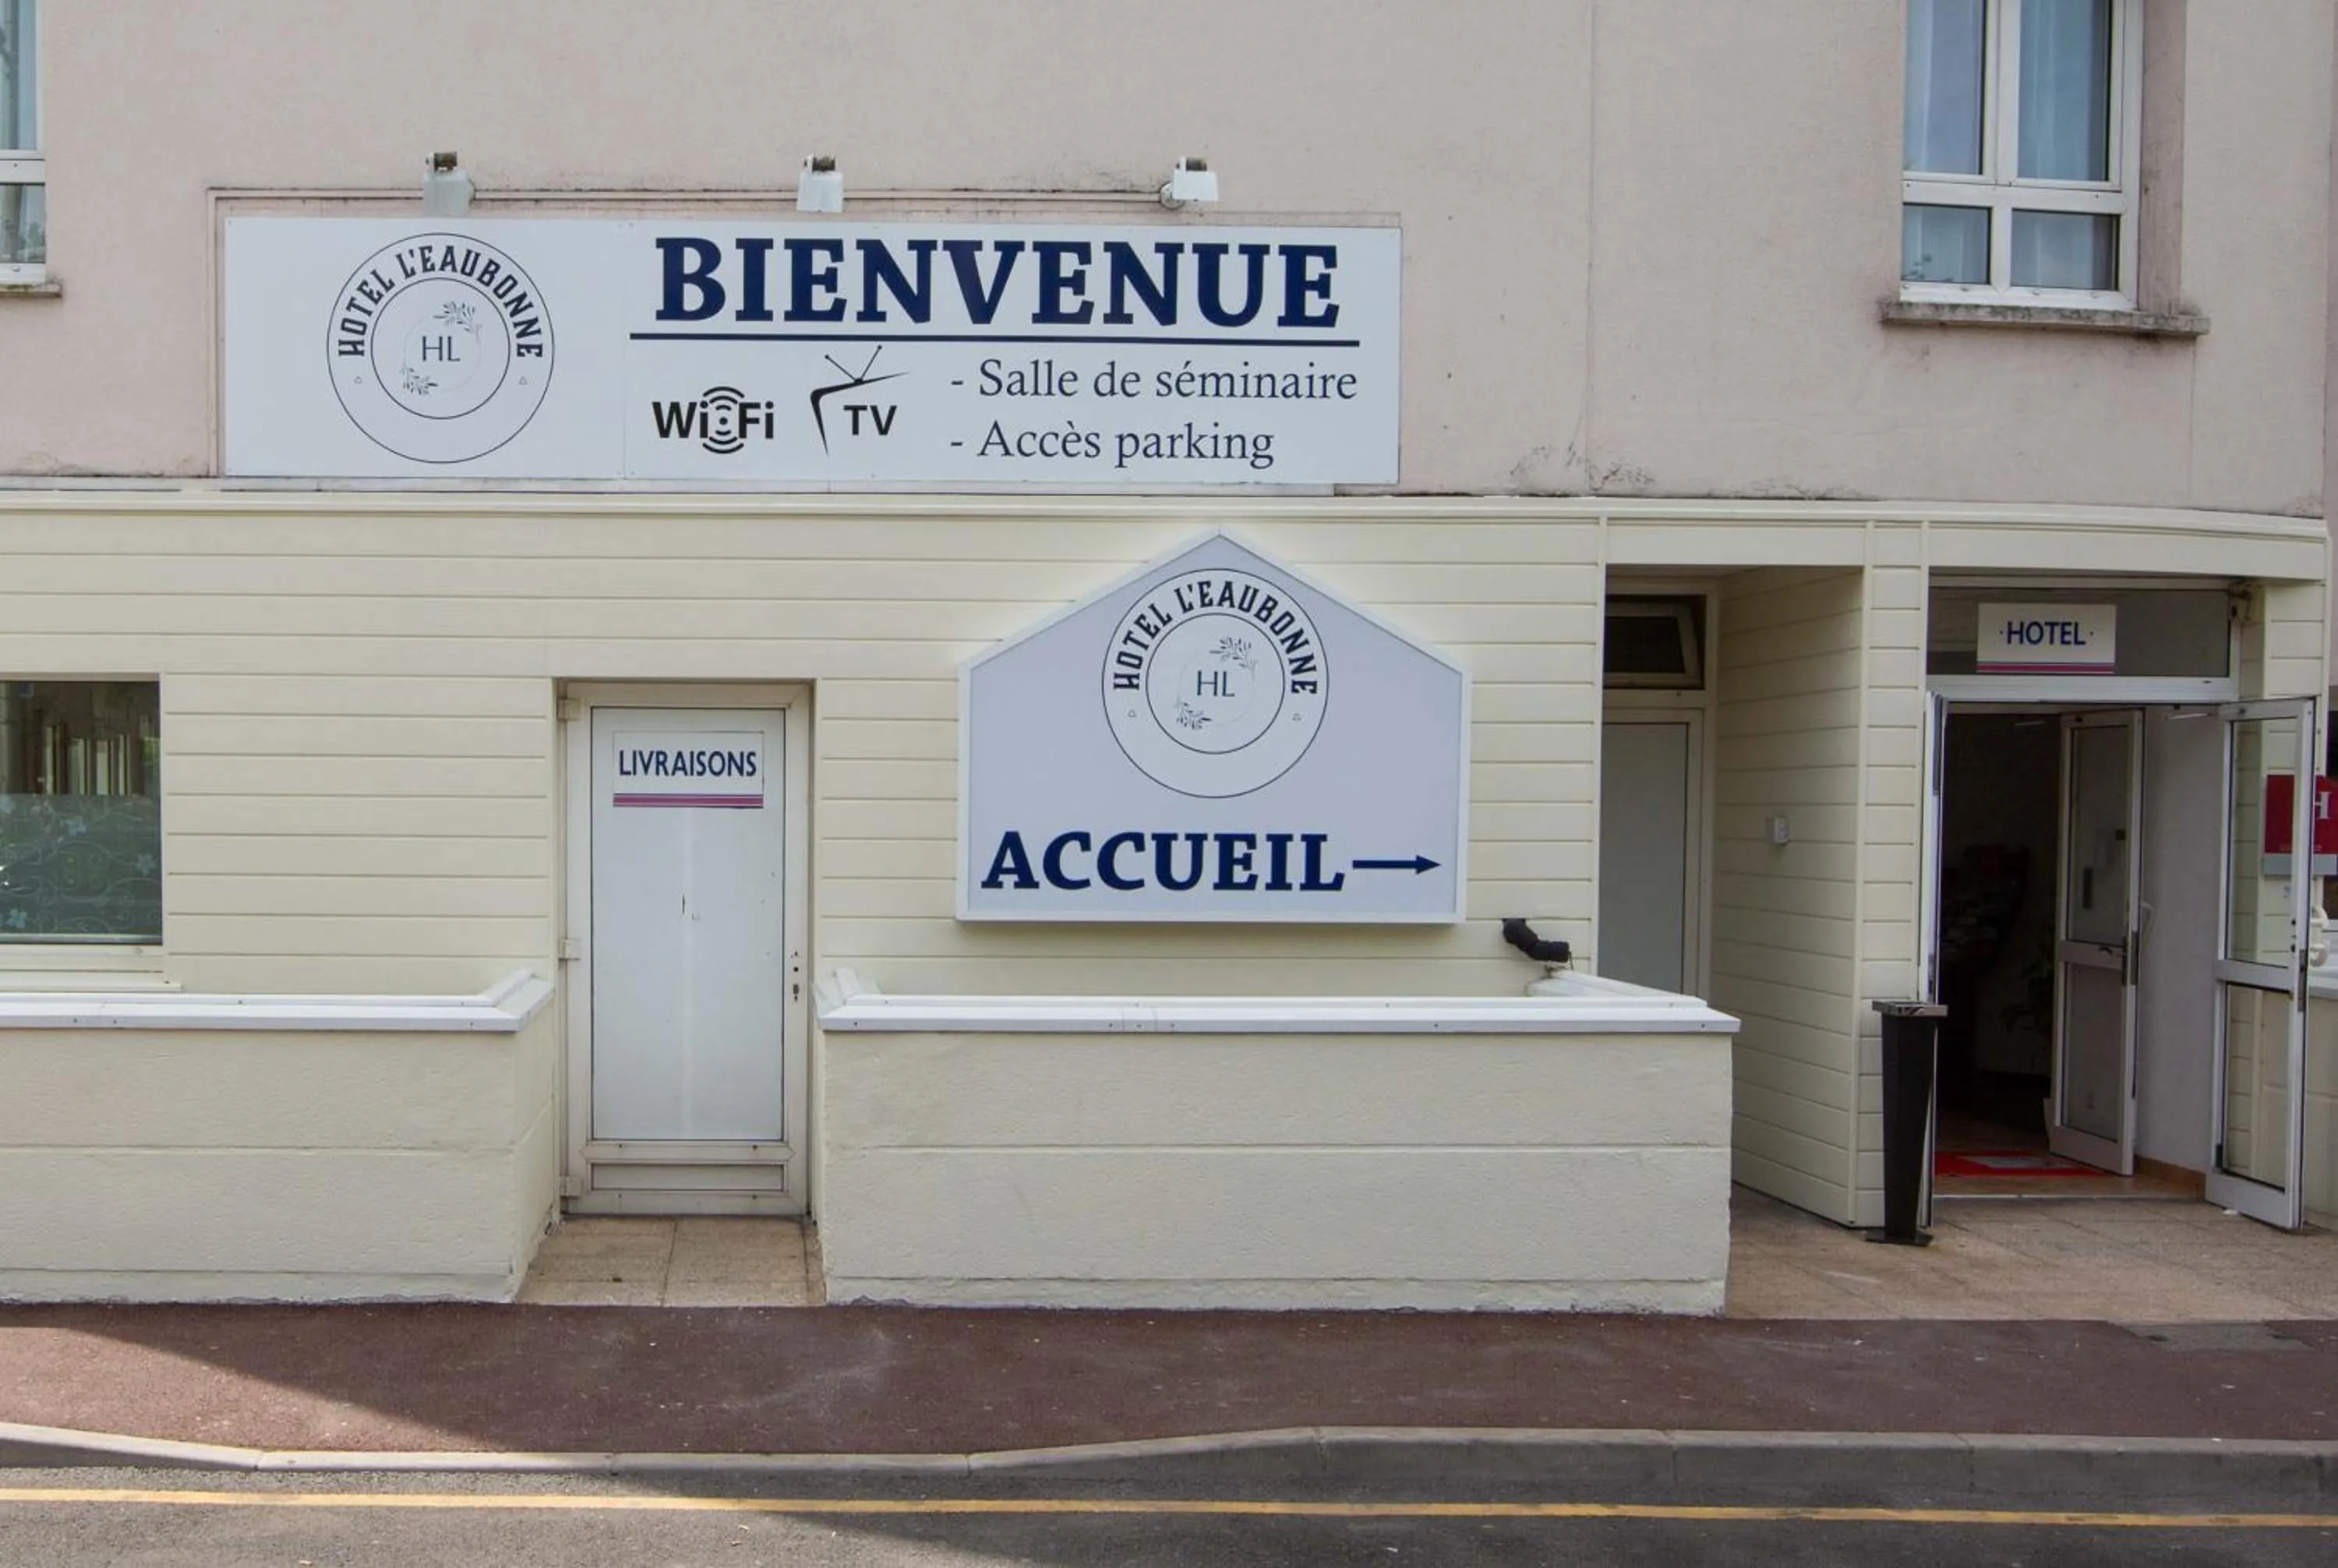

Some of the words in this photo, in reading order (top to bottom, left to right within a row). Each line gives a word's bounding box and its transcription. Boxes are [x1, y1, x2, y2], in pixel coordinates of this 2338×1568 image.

[338, 269, 395, 357] HOTEL
[395, 245, 543, 358] L'EAUBONNE
[656, 236, 1340, 328] BIENVENUE
[422, 335, 461, 362] HL
[979, 358, 1079, 398] Salle
[1093, 360, 1142, 398] de
[1156, 360, 1358, 400] séminaire
[652, 397, 774, 442] WiFi
[843, 404, 898, 436] TV
[977, 419, 1101, 459] Accès
[1114, 422, 1274, 469] parking
[1113, 602, 1173, 690] HOTEL
[1173, 580, 1318, 694] L'EAUBONNE
[2006, 620, 2086, 646] HOTEL
[1196, 669, 1235, 697] HL
[619, 749, 757, 777] LIVRAISONS
[980, 830, 1346, 892] ACCUEIL
